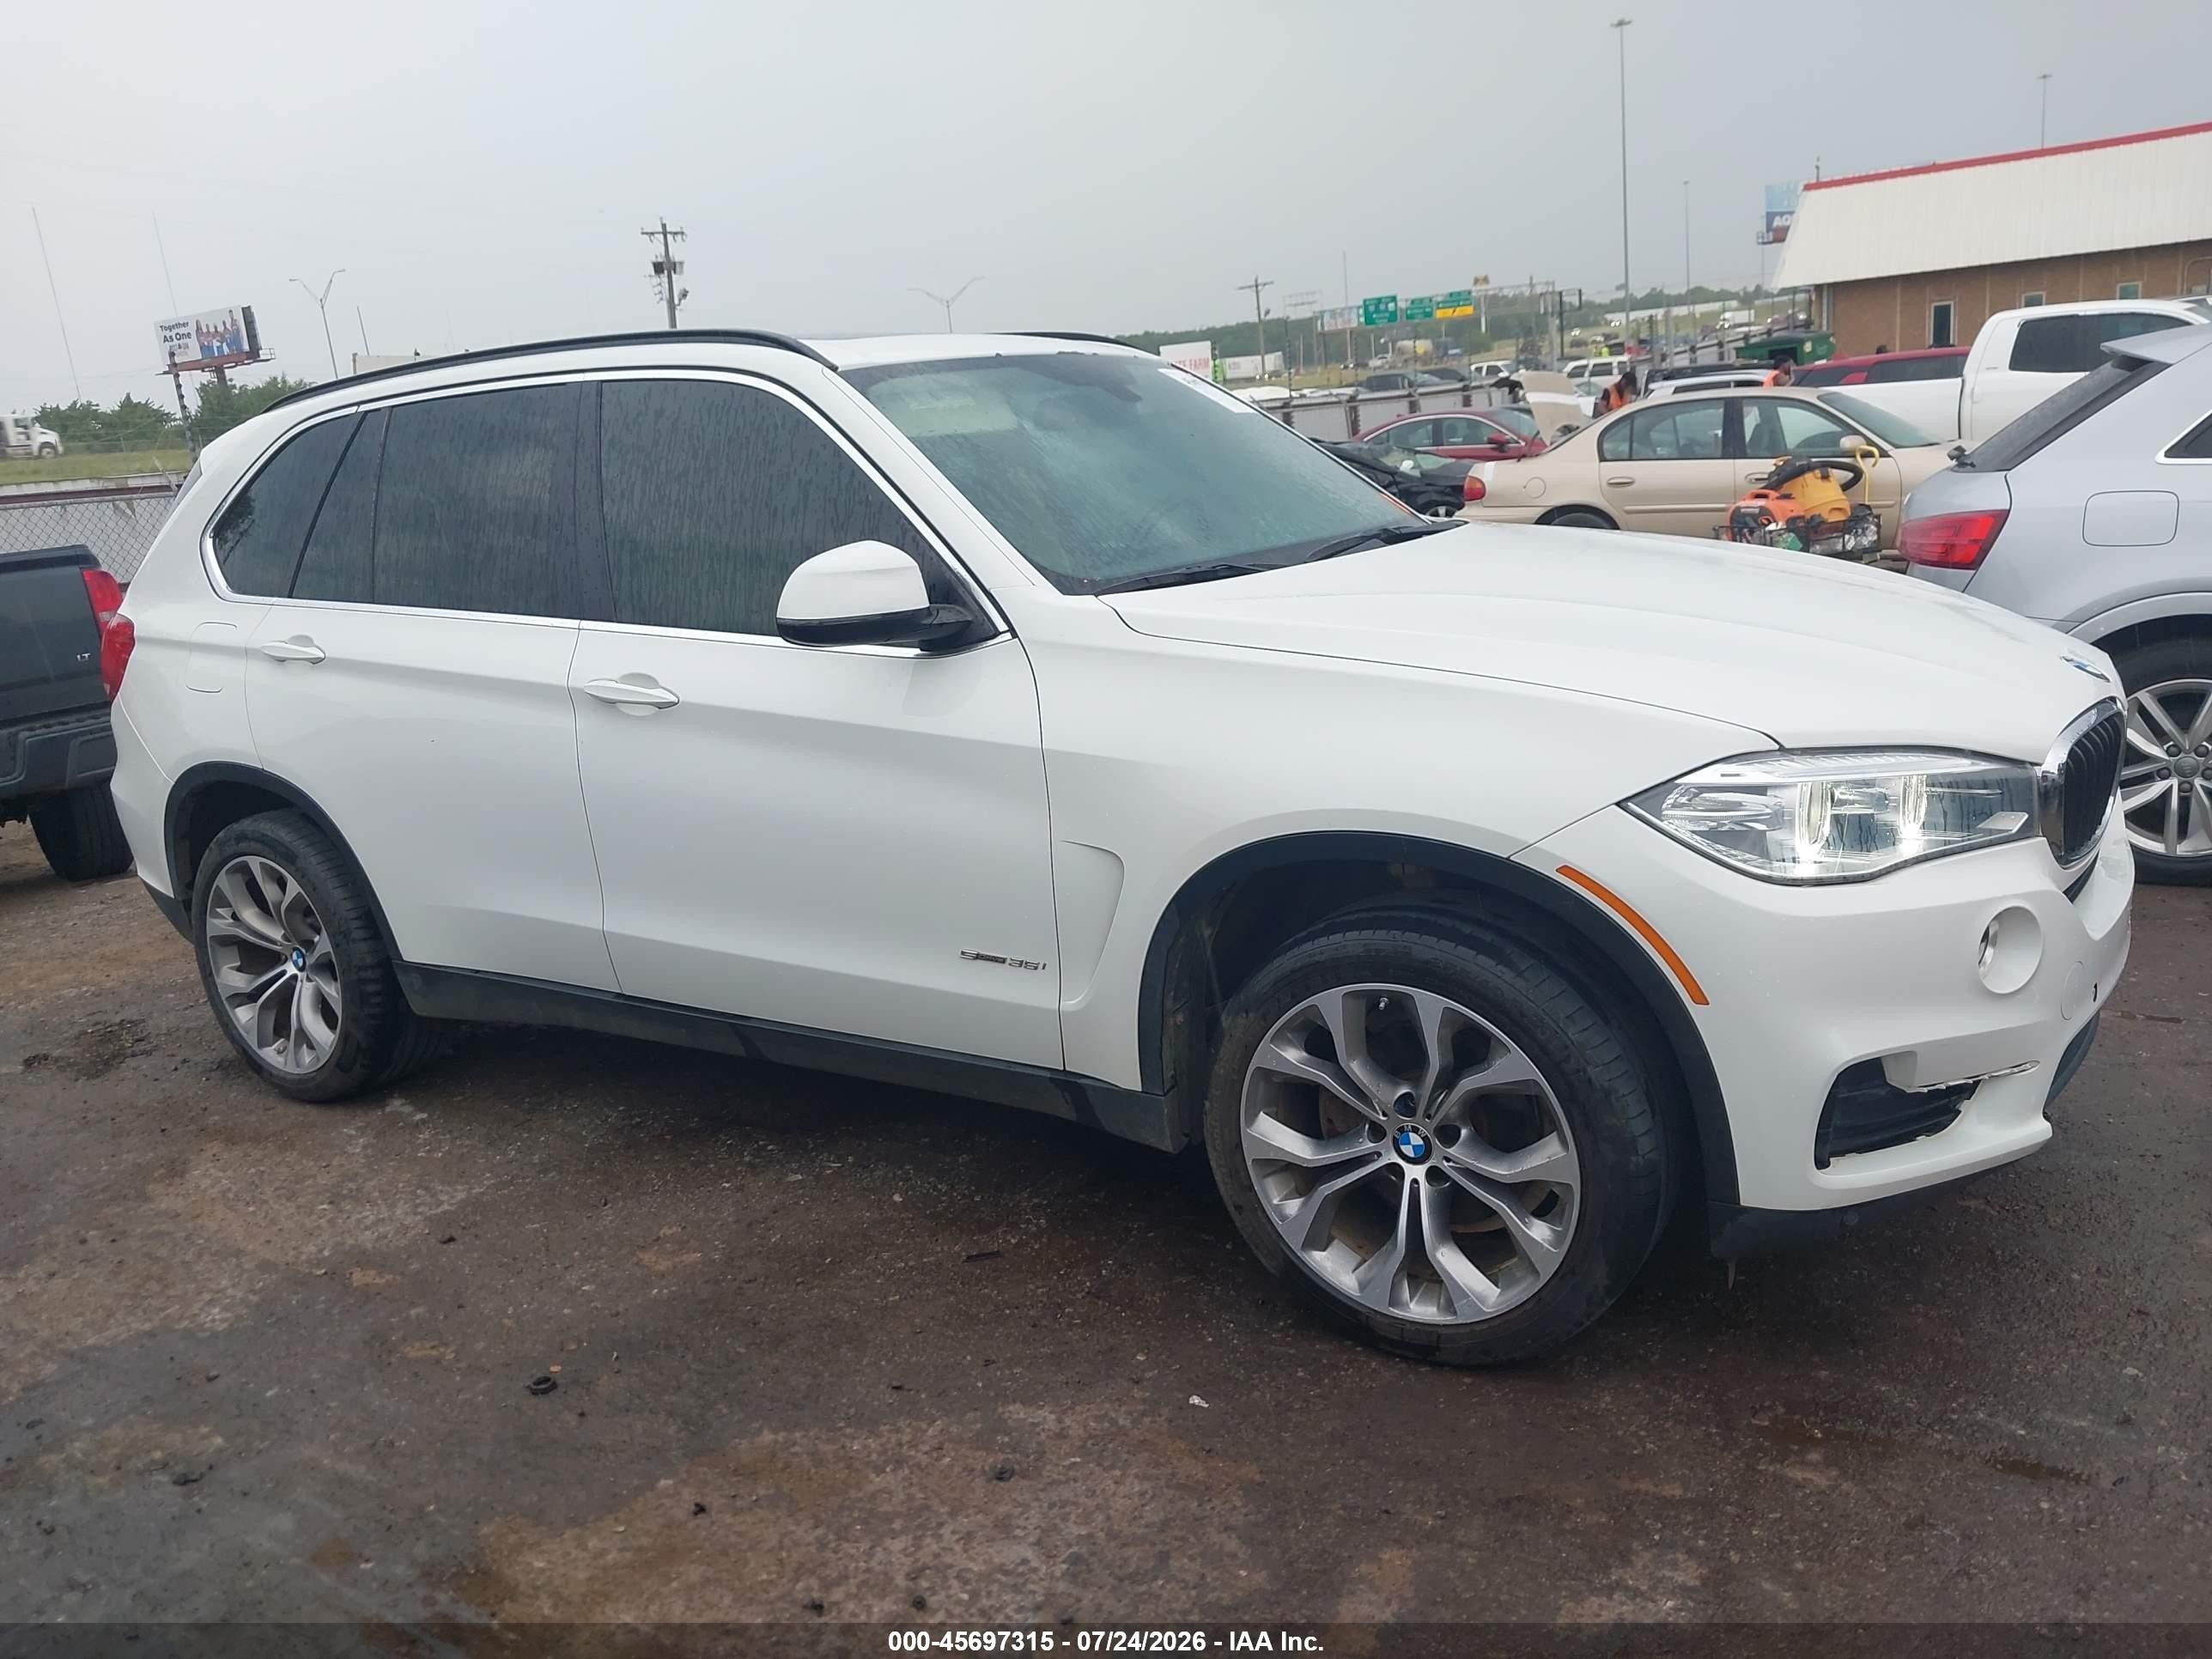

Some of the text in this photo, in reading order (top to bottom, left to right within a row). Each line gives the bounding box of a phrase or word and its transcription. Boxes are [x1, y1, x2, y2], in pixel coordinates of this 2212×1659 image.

[160, 321, 189, 332] Together
[163, 331, 192, 343] As One
[1394, 1124, 1427, 1139] BMW
